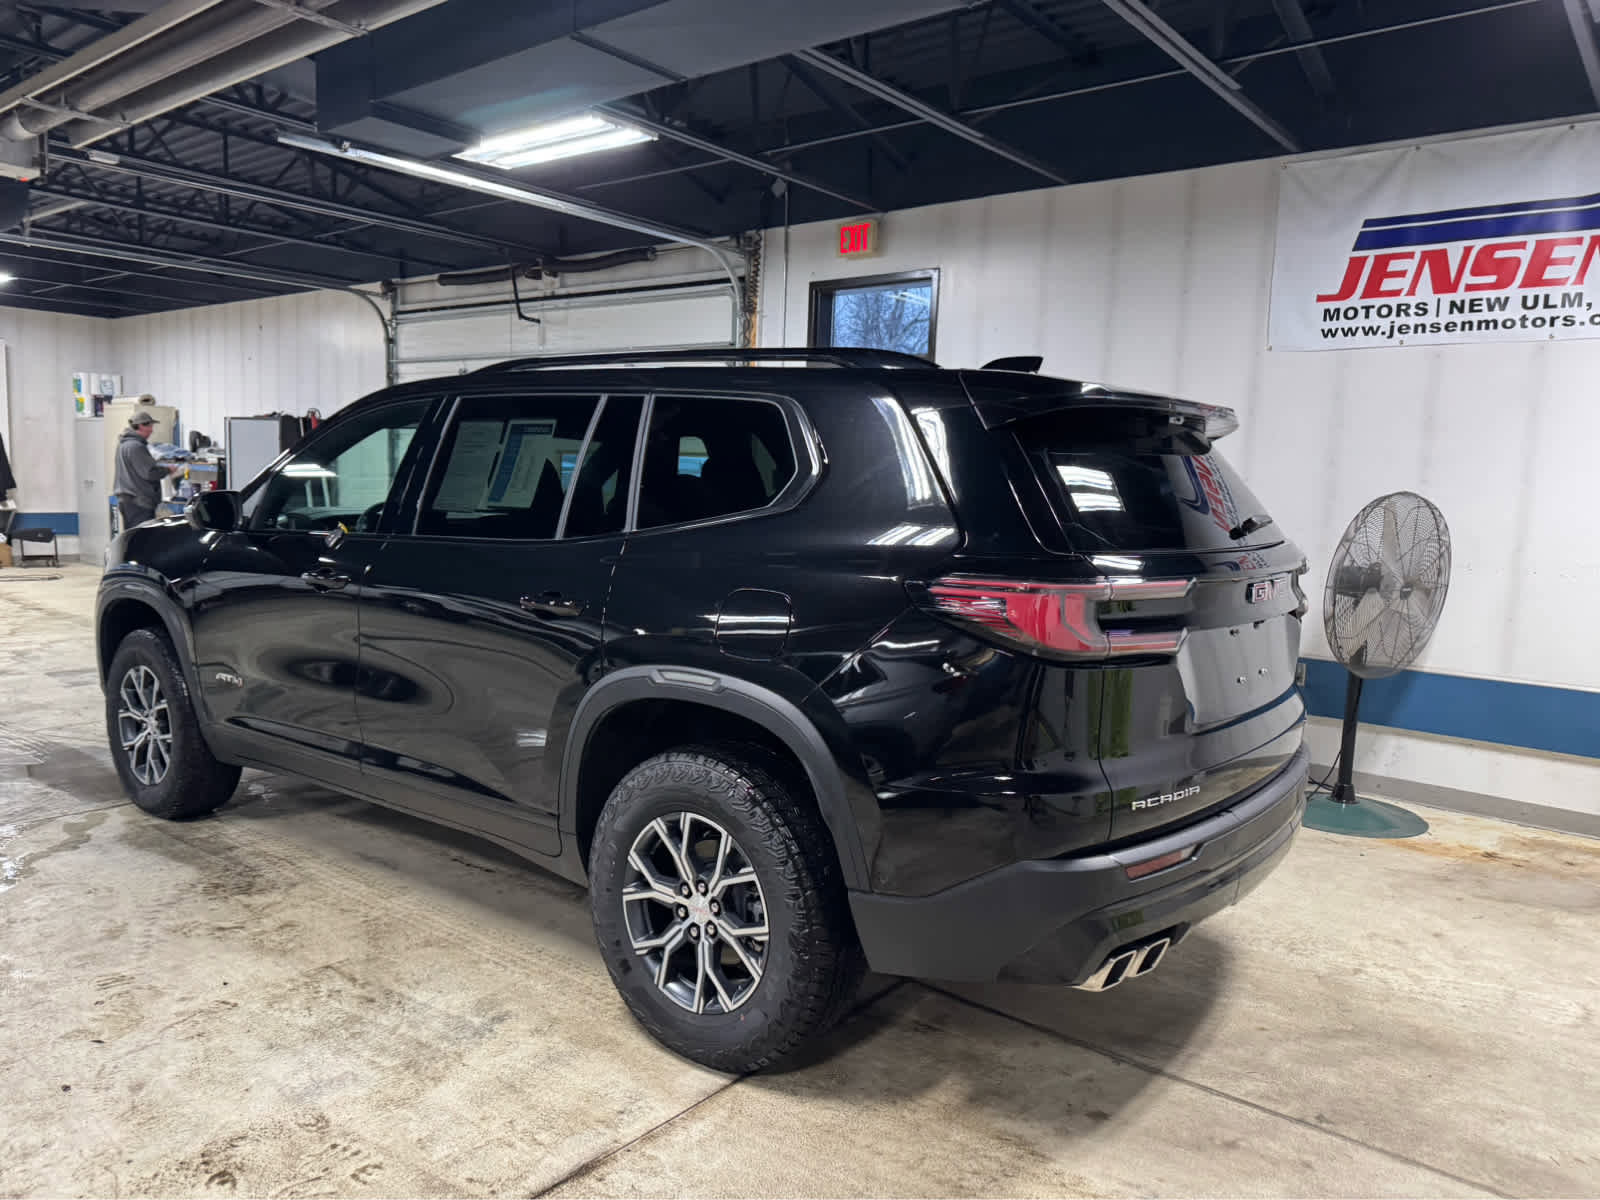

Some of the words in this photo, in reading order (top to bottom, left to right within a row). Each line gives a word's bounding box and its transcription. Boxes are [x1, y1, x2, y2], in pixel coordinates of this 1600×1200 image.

[840, 222, 871, 254] EXIT
[1322, 302, 1428, 322] MOTORS
[1448, 296, 1510, 315] NEW
[1521, 291, 1592, 311] ULM,
[1131, 785, 1200, 811] ACADIA
